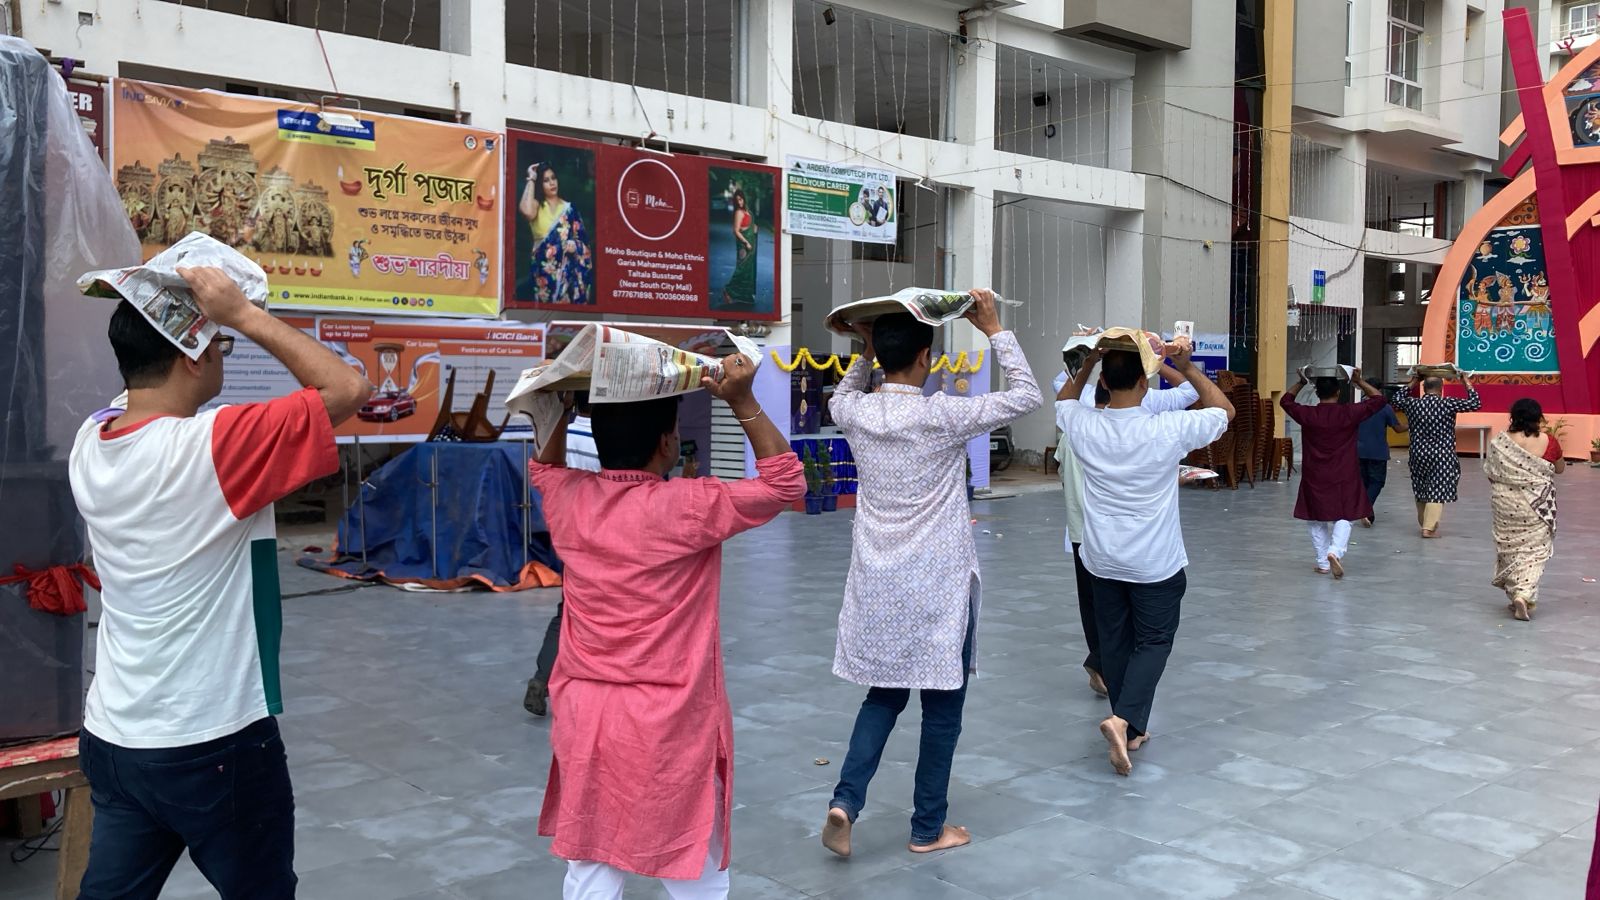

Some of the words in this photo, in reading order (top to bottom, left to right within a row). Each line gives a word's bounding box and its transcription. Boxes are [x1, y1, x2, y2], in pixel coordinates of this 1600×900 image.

[806, 163, 831, 173] ARDENT
[831, 166, 866, 179] COMPUTECH
[363, 162, 407, 199] দূর্গা
[413, 173, 475, 204] পূজার
[789, 175, 808, 185] BUILD
[808, 178, 826, 188] YOUR
[826, 181, 850, 192] CAREER
[605, 246, 626, 256] Moho
[626, 247, 657, 260] Boutique
[658, 251, 664, 259] &
[664, 251, 683, 260] Moho
[683, 253, 705, 262] Ethnic
[372, 254, 407, 275] শুভ
[406, 252, 471, 280] শারদীয়া
[617, 258, 636, 267] Garia
[637, 260, 686, 272] Mahamayatala
[686, 263, 693, 271] &
[628, 269, 651, 278] Taltala
[652, 271, 683, 281] Busstand
[619, 279, 639, 289] (Near
[640, 281, 660, 290] South
[660, 282, 675, 292] City
[675, 283, 693, 293] Mall)
[293, 292, 354, 302] www.indianbank.in
[492, 332, 515, 340] ICICI
[515, 332, 539, 341] Bank
[461, 346, 488, 354] Features
